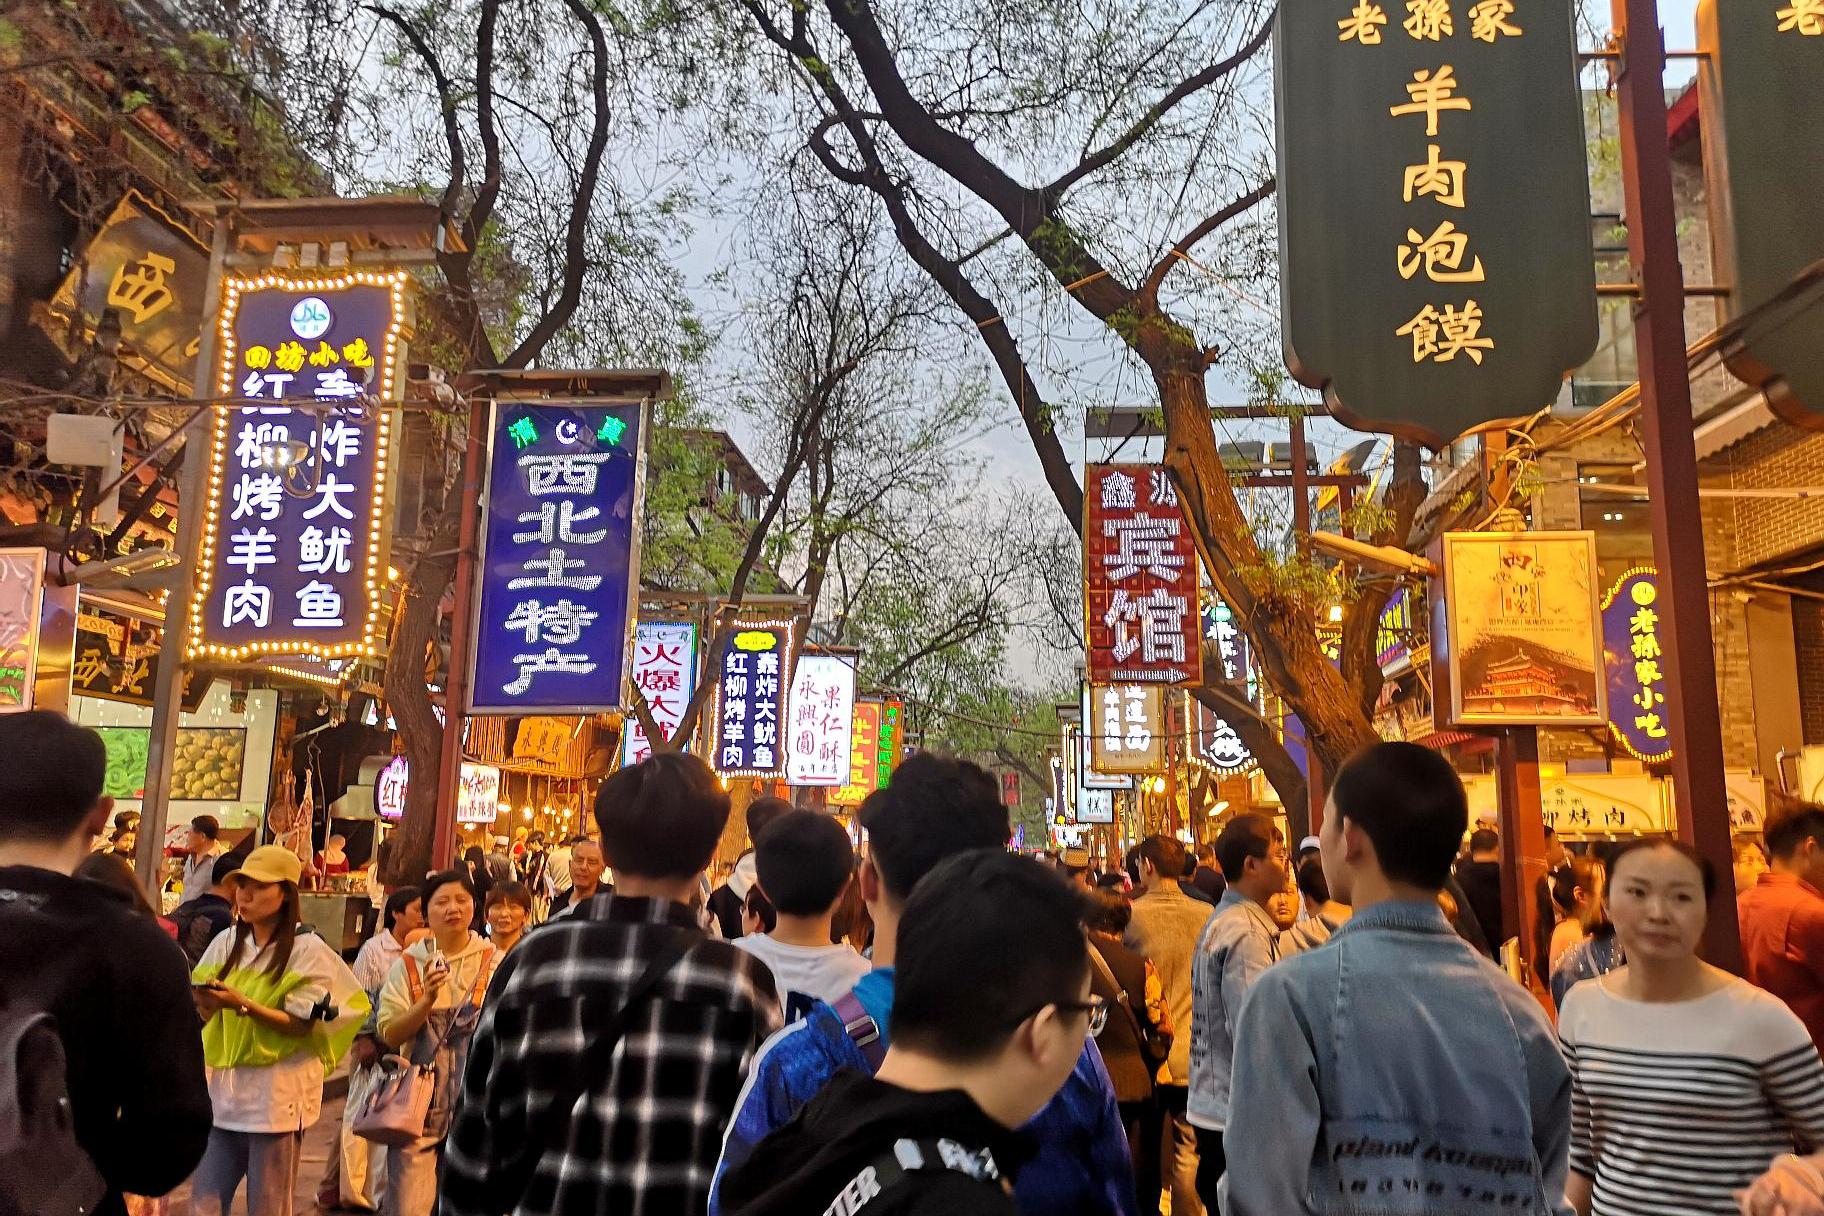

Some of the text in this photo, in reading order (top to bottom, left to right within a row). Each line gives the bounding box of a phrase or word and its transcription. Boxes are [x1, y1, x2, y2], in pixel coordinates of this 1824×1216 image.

[502, 452, 611, 696] 西北土特产
[1102, 512, 1188, 664] 宾馆
[722, 652, 749, 768] 红柳烤羊肉
[752, 651, 778, 768] 轰炸大鱿鱼
